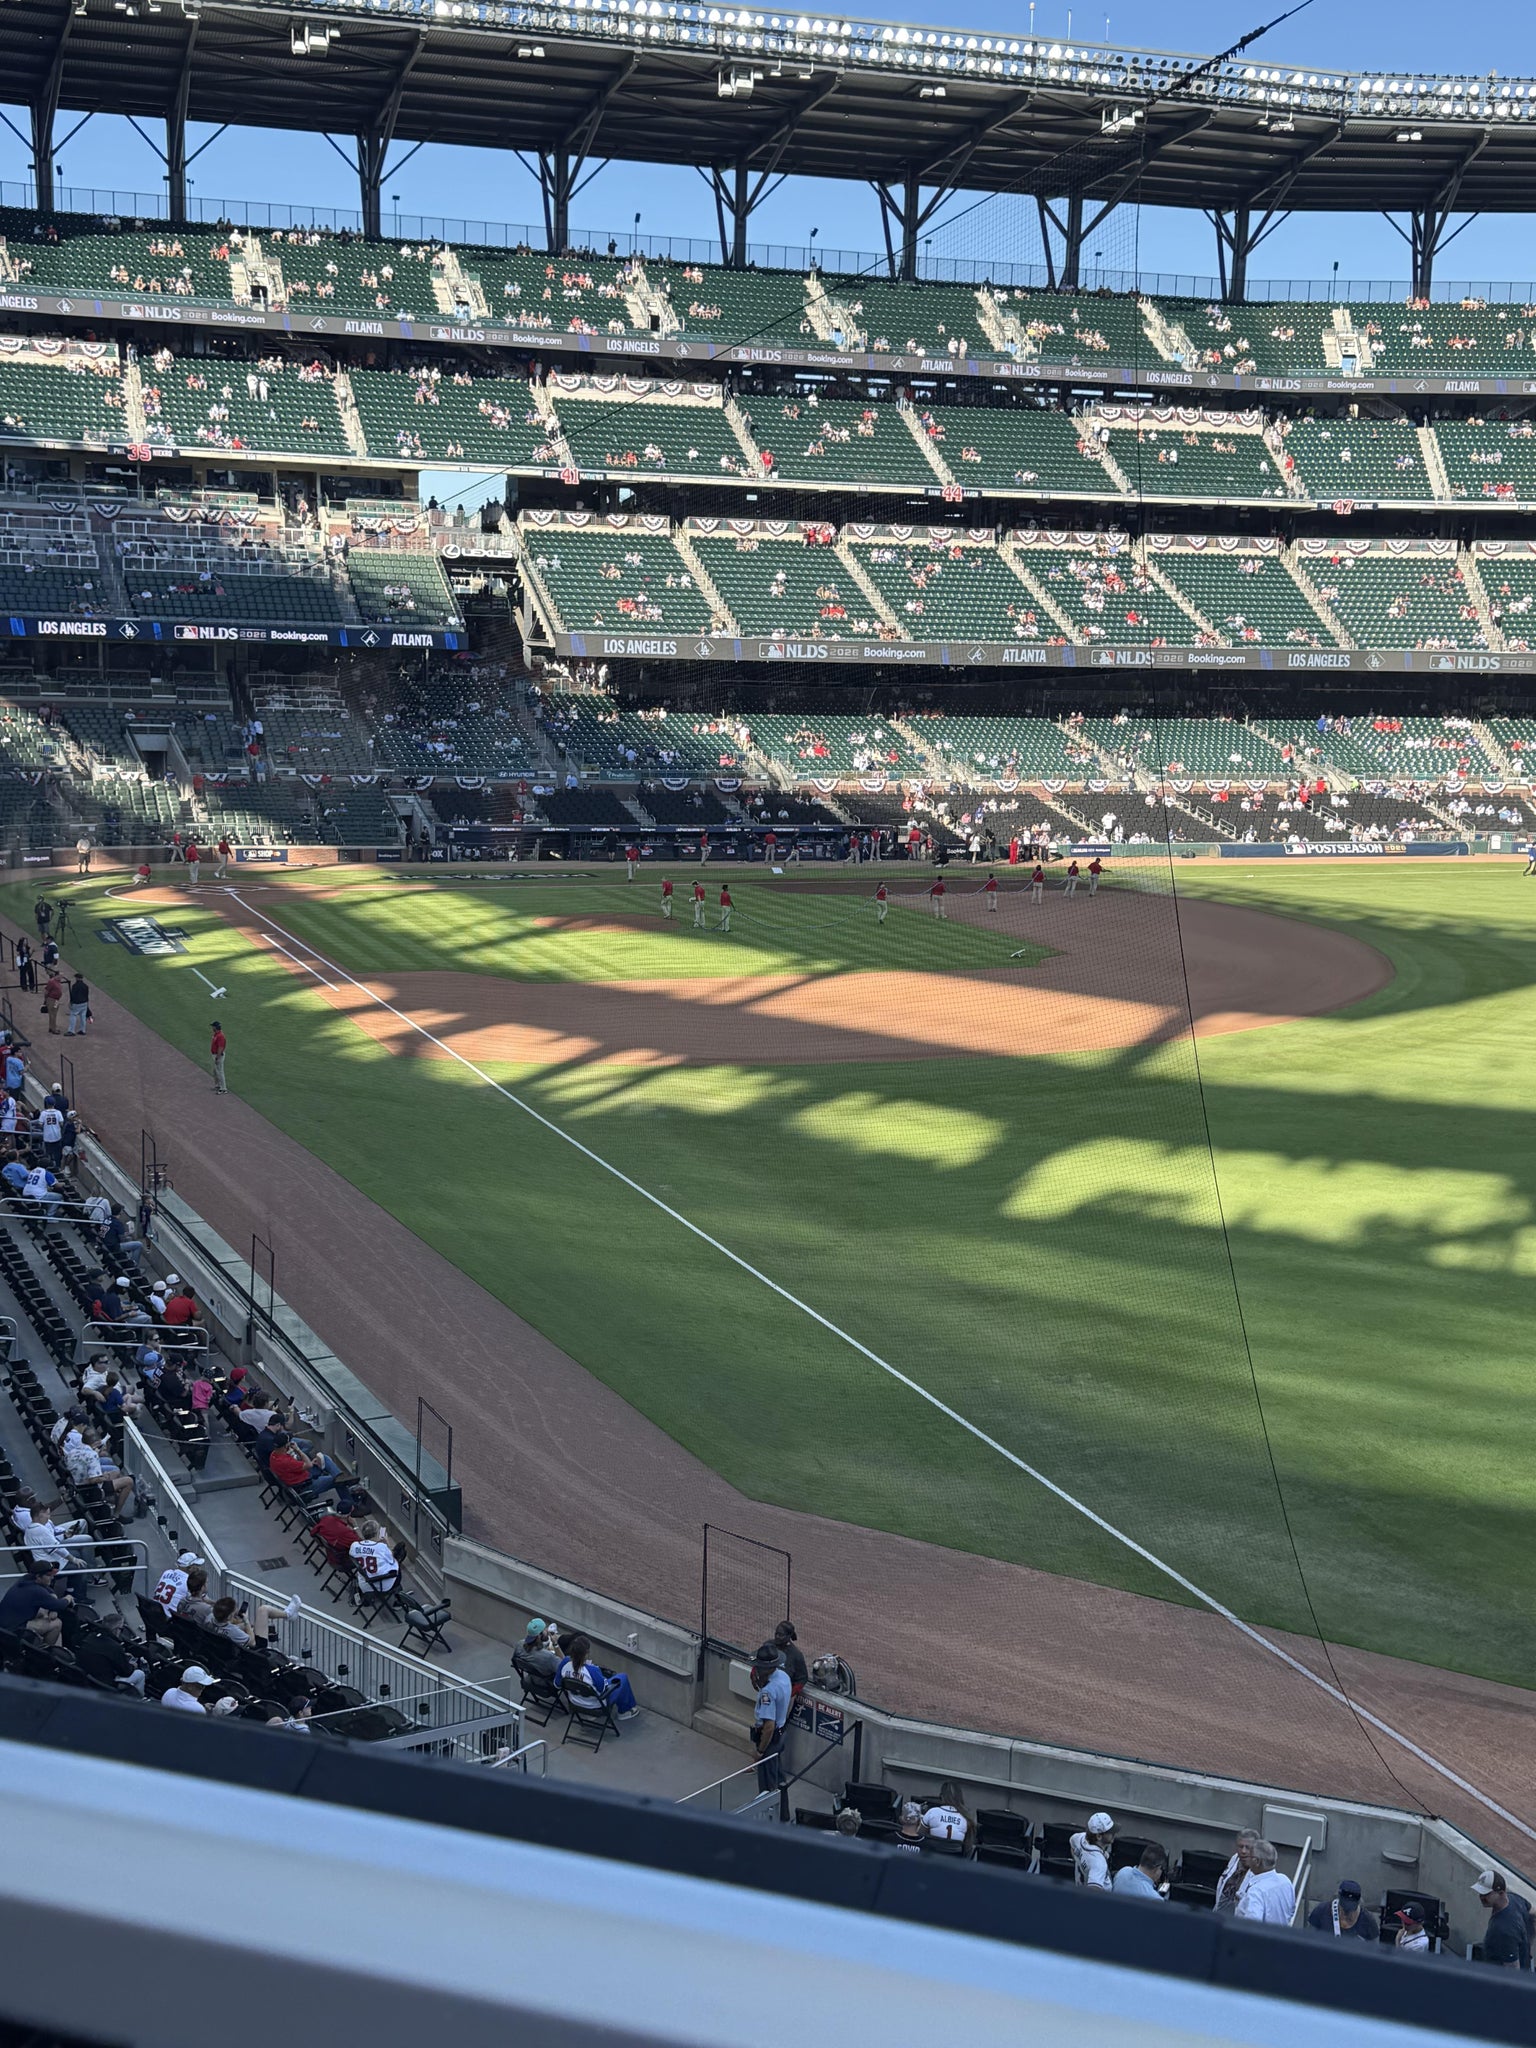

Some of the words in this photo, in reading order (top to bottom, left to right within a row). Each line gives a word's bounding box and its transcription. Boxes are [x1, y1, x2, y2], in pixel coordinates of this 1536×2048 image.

[145, 306, 181, 320] NLDS
[211, 312, 266, 325] Booking.com
[345, 321, 383, 335] ATLANTA
[452, 328, 485, 341] NLDS
[512, 333, 562, 346] Booking.com
[607, 339, 622, 351] LOS
[623, 341, 660, 353] ANGELES
[751, 349, 782, 361] NLDS
[807, 353, 853, 364] Booking.com
[920, 360, 954, 372] ATLANTA
[1012, 365, 1041, 377] NLDS
[1064, 368, 1108, 379] Booking.com
[1146, 372, 1160, 383] LOS
[1160, 373, 1193, 385] ANGELES
[1272, 379, 1301, 390] NLDS
[1327, 380, 1374, 391] Booking.com
[1445, 381, 1480, 392] ATLANTA
[128, 443, 152, 461] 35
[560, 468, 579, 484] 41
[942, 485, 962, 502] 44
[1333, 499, 1354, 514] 47
[461, 548, 513, 558] LEXUS
[38, 621, 59, 634] LOS
[59, 622, 107, 636] ANGELES
[199, 627, 238, 640] NLDS
[271, 630, 328, 642] Booking.com
[391, 633, 433, 646] ATLANTA
[604, 639, 626, 653] LOS
[626, 640, 677, 655] ANGELES
[786, 644, 828, 658] NLDS
[864, 647, 926, 660] Booking.com
[1002, 649, 1047, 663] ATLANTA
[1116, 651, 1155, 665] NLDS
[1188, 653, 1246, 666] Booking.com
[1288, 654, 1306, 667] LOS
[1307, 654, 1350, 667] ANGELES
[1457, 656, 1501, 670] NLDS
[1306, 843, 1383, 854] POSTSEASON
[355, 1546, 375, 1555] OLSON
[153, 1581, 176, 1604] 23
[826, 1706, 842, 1718] ALERT
[940, 1815, 961, 1825] ALBIES
[946, 1825, 953, 1840] 1
